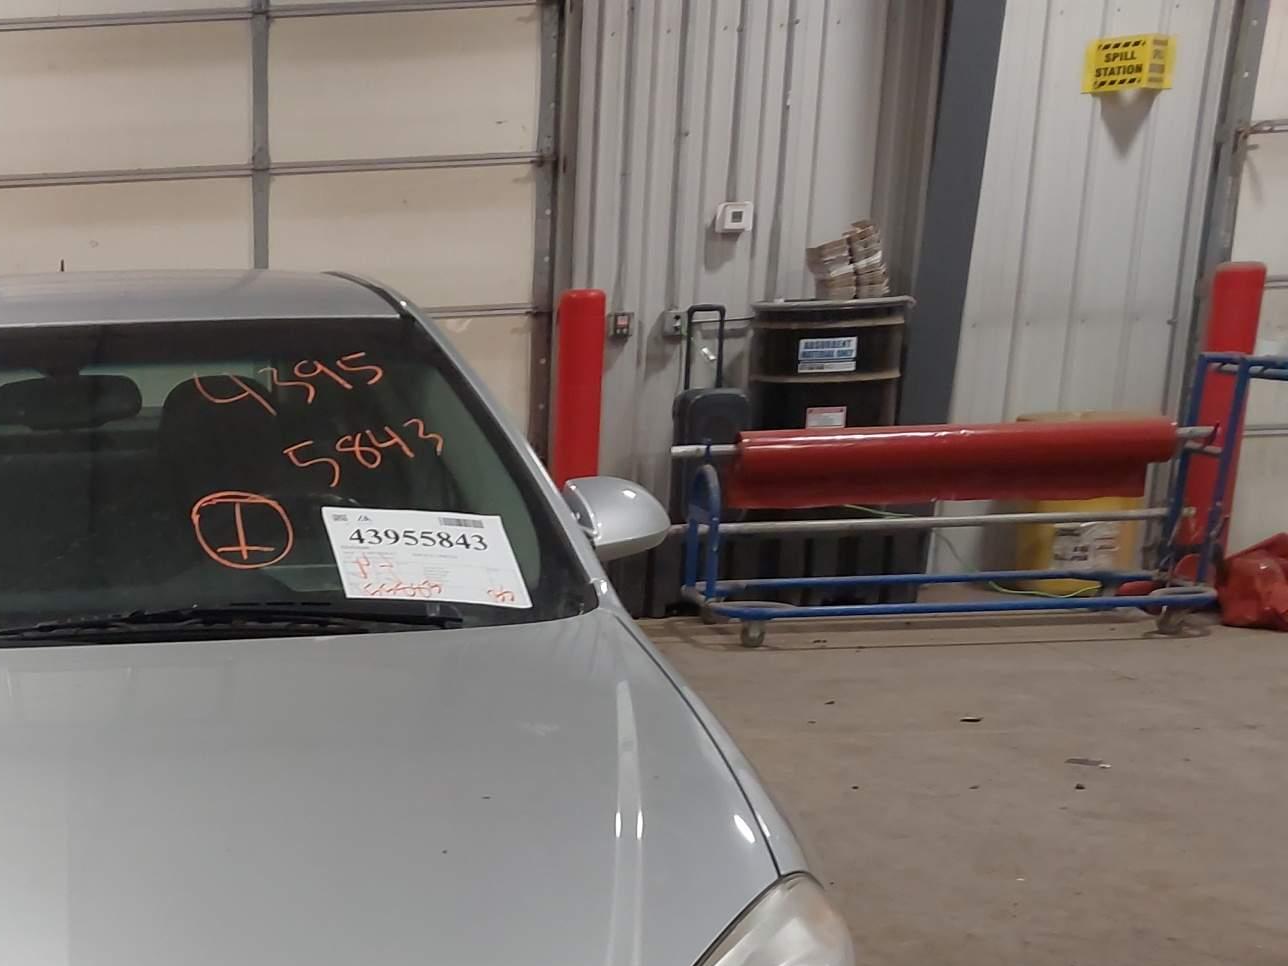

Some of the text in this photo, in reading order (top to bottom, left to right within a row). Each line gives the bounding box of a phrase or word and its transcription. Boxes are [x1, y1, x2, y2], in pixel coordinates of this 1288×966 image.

[1103, 50, 1136, 63] SPILL
[1094, 63, 1143, 78] STATION
[193, 351, 385, 417] 4395
[282, 418, 444, 488] 5843
[348, 528, 489, 552] 43955843
